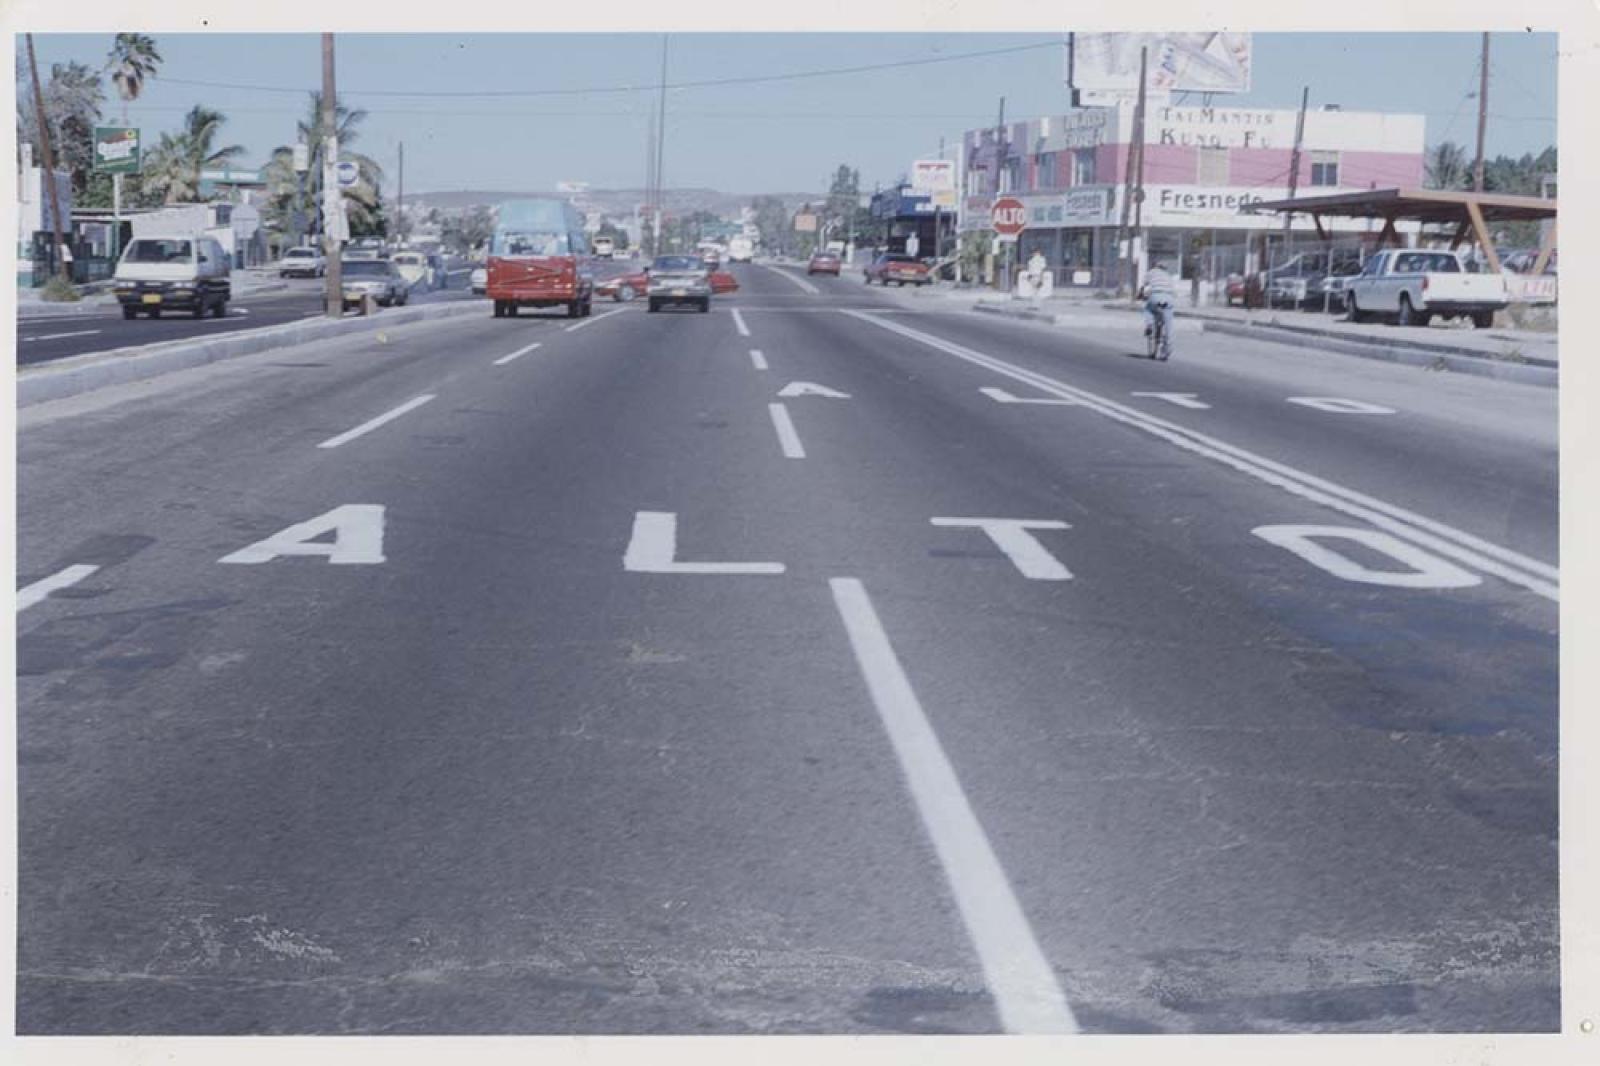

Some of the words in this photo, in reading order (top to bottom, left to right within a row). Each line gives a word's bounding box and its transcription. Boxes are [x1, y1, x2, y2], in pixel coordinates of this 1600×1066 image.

[992, 207, 1025, 225] ALTO
[776, 381, 1397, 414] ALTO
[217, 504, 1483, 588] ALTO
